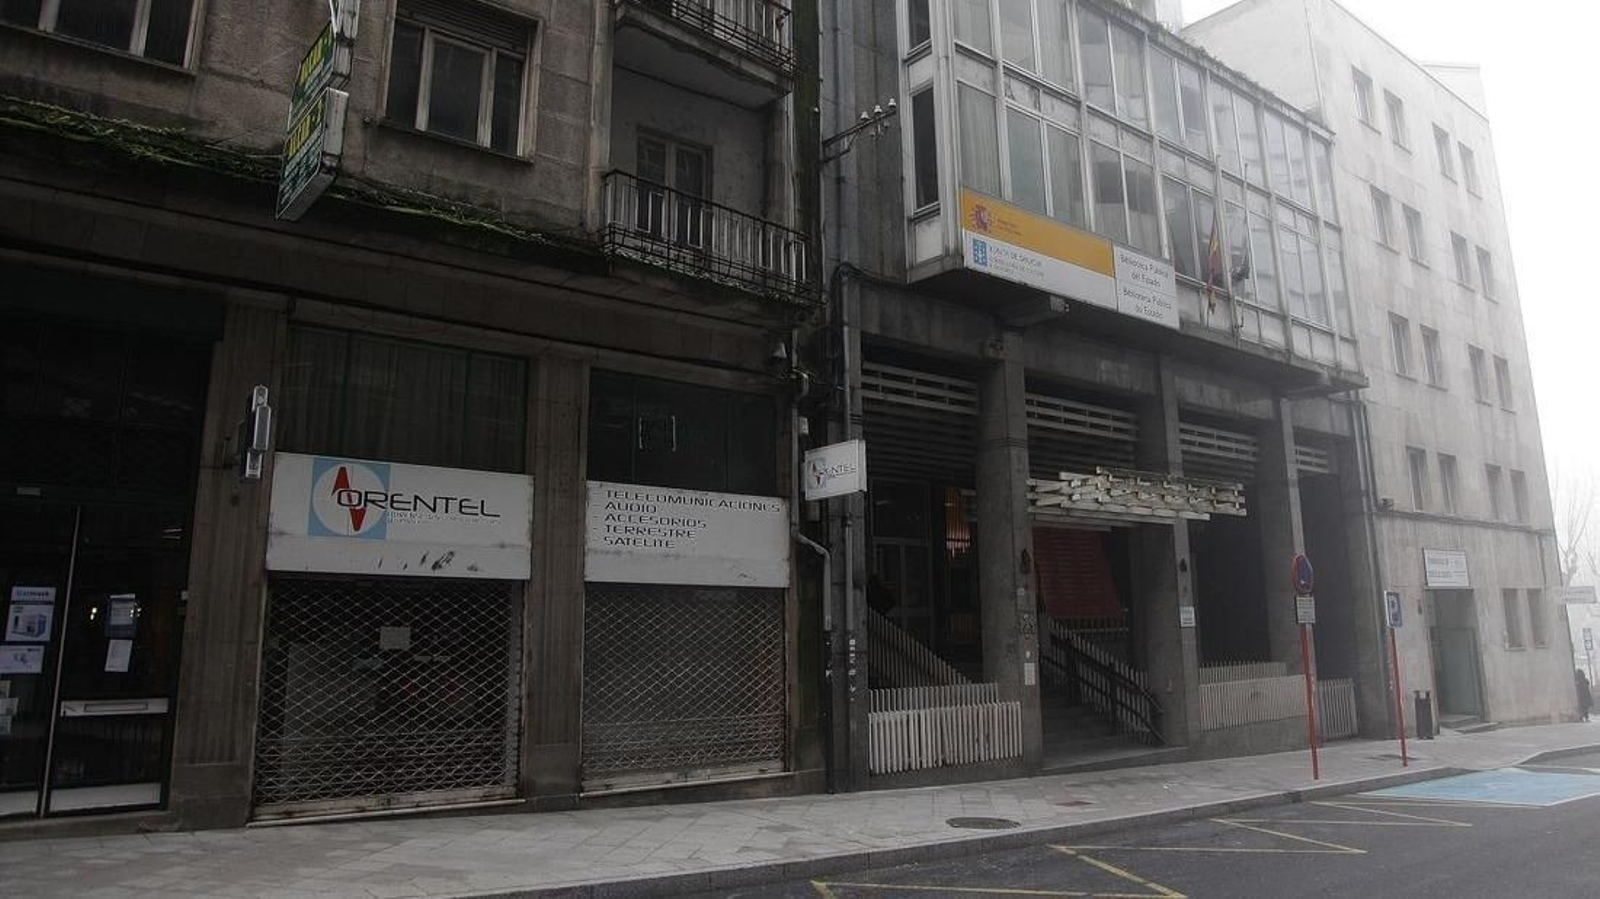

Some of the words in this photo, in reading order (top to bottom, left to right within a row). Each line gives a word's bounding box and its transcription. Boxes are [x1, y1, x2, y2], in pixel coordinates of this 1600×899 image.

[337, 488, 501, 517] ORENTEL
[605, 490, 781, 513] TELECOMUNICACIONES
[605, 501, 657, 514] AUDIO
[605, 513, 707, 528] ACCESORIOS
[605, 525, 697, 539] TERRESTRE
[604, 536, 676, 549] SATELITE
